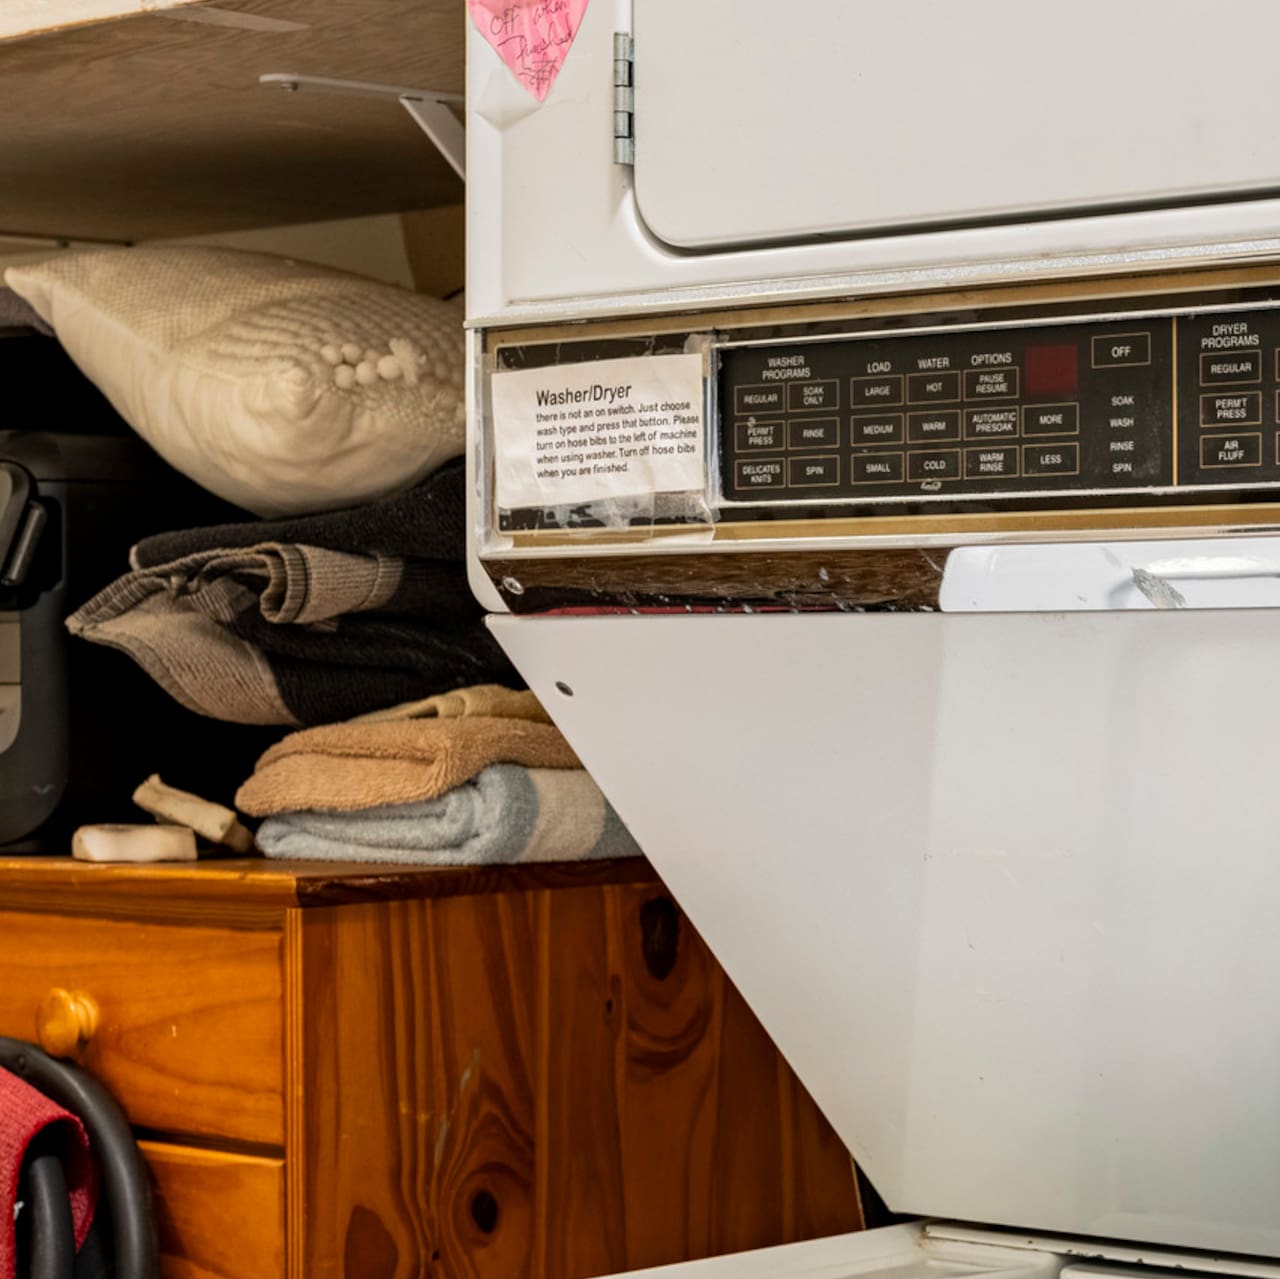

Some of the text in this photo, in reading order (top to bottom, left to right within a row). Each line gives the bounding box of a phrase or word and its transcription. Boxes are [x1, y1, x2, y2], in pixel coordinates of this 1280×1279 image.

[1212, 323, 1248, 336] DRYER
[1201, 334, 1260, 348] PROGRAMS
[1111, 346, 1131, 358] OFF
[767, 355, 805, 368] WASHER
[917, 357, 950, 369] WATER
[971, 352, 1013, 365] OPTIONS
[761, 367, 811, 379] PROGRAMS
[866, 361, 892, 373] LOAD
[1210, 362, 1252, 374] REGULAR
[979, 373, 1005, 384] PAUSE
[803, 386, 824, 396] SOAK
[864, 385, 891, 397] LARGE
[926, 382, 944, 393] HOT
[975, 382, 1009, 394] RESUME
[536, 384, 632, 407] Washer/Dryer
[743, 393, 778, 405] REGULAR
[803, 395, 824, 406] ONLY
[1111, 394, 1134, 406] SOAK
[536, 401, 691, 422] there is not an on switch. Just choose
[1217, 408, 1247, 420] PRESS
[972, 412, 1017, 424] AUTOMATIC
[1039, 413, 1063, 425] MORE
[1109, 417, 1134, 428] WASH
[537, 415, 700, 436] wash type and press that button. Please
[863, 424, 893, 436] MEDIUM
[922, 421, 947, 432] WARM
[975, 421, 1013, 433] PRESOAK
[802, 427, 824, 439] RINSE
[537, 429, 697, 451] turn on hose bibs to the left of machine
[748, 436, 774, 446] PRESS
[1109, 440, 1135, 451] RINSE
[1224, 441, 1240, 451] AIR
[537, 443, 695, 465] when using washer. Turn off hose bibs
[979, 452, 1004, 463] WARM
[1040, 454, 1062, 466] LESS
[1218, 449, 1244, 461] FLUFF
[537, 463, 629, 479] when you are finished.
[742, 464, 781, 476] DELICATES
[806, 465, 824, 476] SPIN
[866, 462, 891, 474] SMALL
[923, 460, 946, 471] COLD
[979, 462, 1003, 472] RINSE
[1112, 462, 1133, 473] SPIN
[750, 474, 773, 484] KNITS
